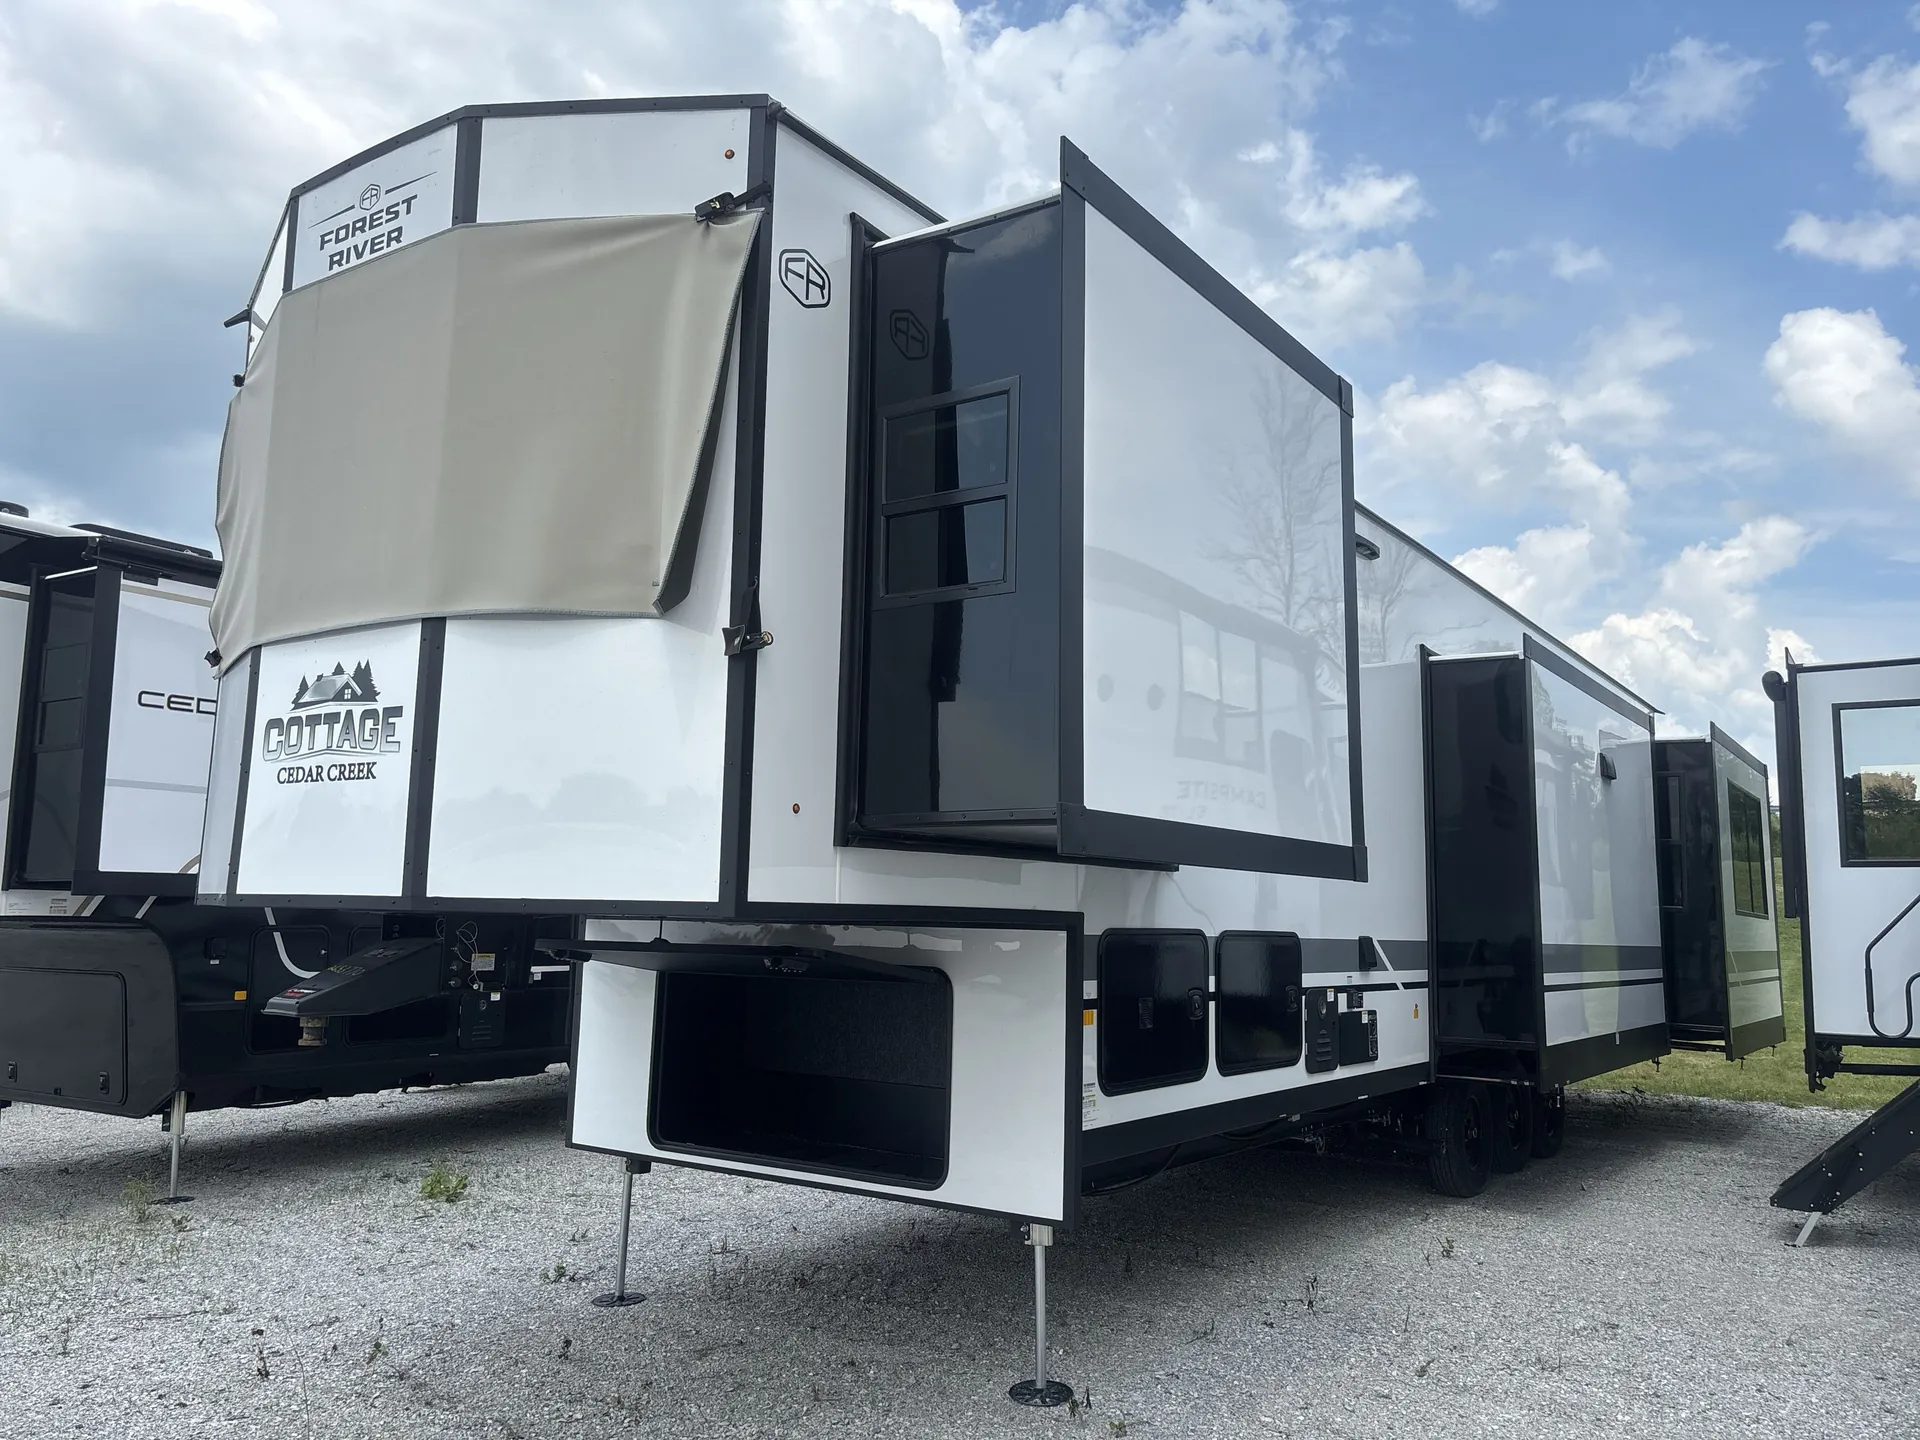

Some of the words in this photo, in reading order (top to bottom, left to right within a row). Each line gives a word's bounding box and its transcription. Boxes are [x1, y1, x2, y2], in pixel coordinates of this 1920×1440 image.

[320, 194, 418, 251] FOREST
[328, 226, 403, 271] RIVER
[783, 255, 828, 303] FR
[262, 705, 404, 762] COTTAGE
[277, 765, 325, 785] CEDAR
[327, 762, 377, 782] CREEK
